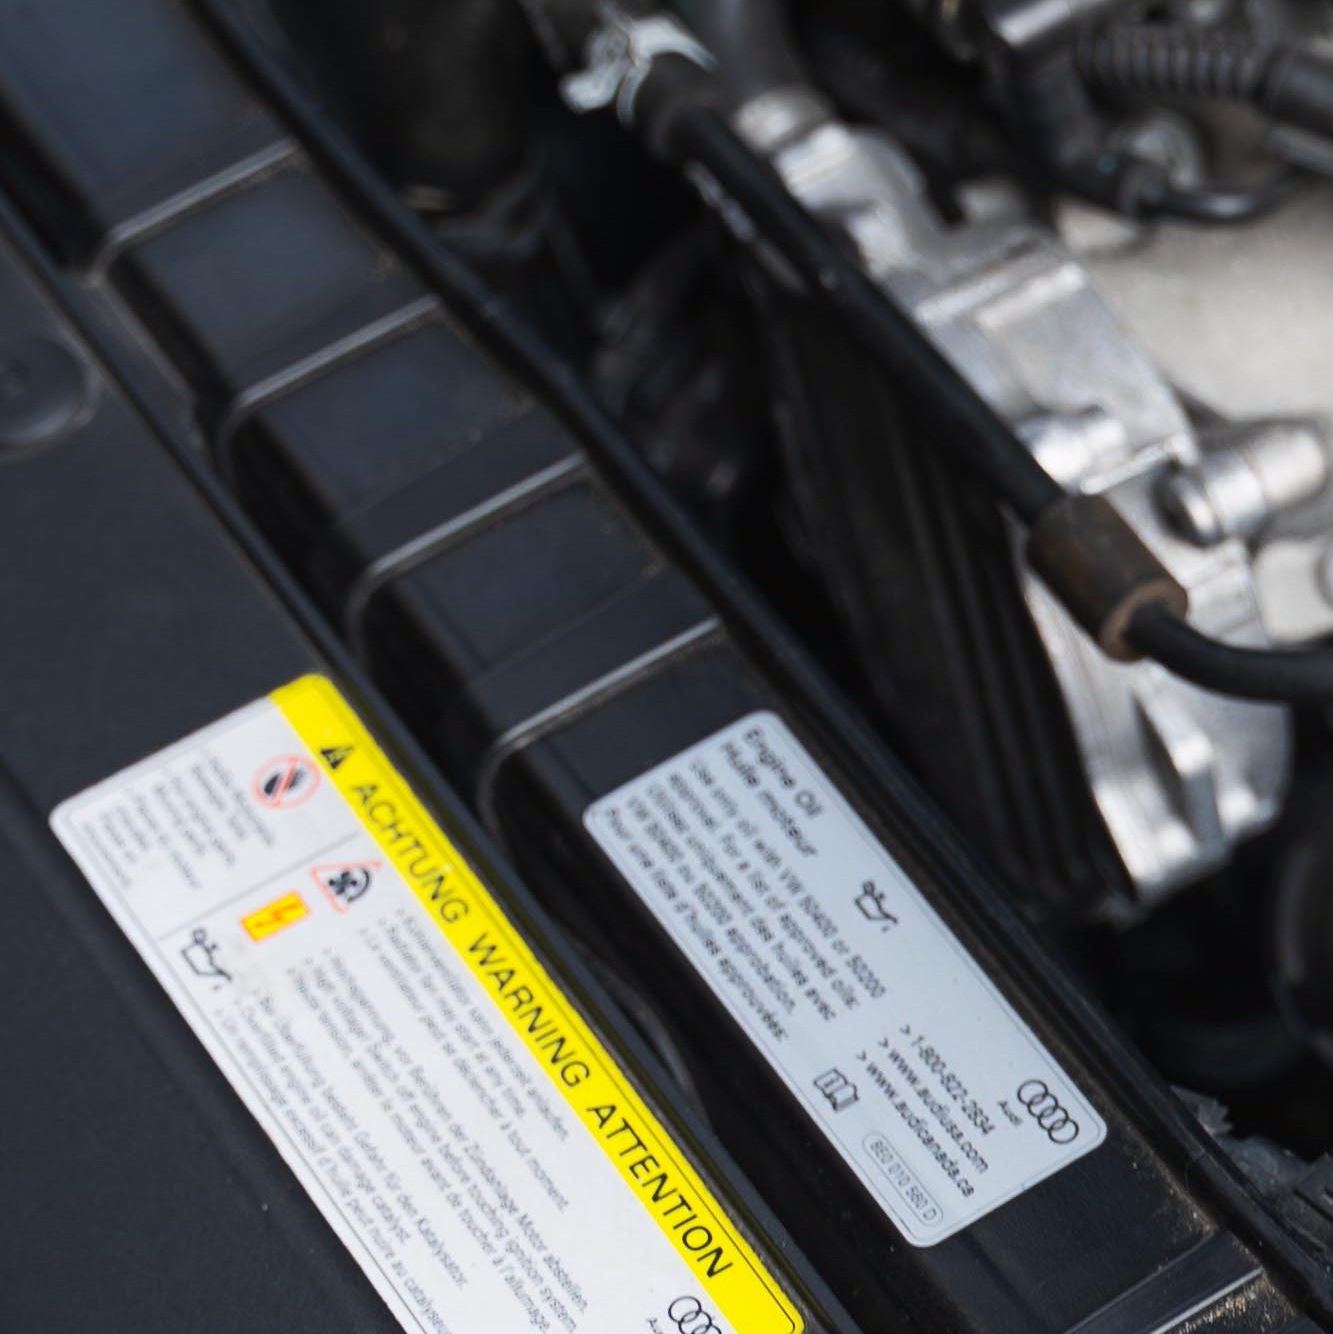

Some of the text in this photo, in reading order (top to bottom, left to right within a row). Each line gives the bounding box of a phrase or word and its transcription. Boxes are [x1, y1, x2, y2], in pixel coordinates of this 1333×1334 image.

[720, 741, 817, 857] Huile moteur
[741, 727, 824, 819] Engine Oil
[351, 780, 733, 1279] ACHTUNG WARNING ATTENTION
[803, 986, 838, 1022] avec
[864, 1062, 976, 1198] www.audicanada.ca
[886, 1048, 990, 1174] www.audiusa.com
[996, 1099, 1023, 1127] Audi
[456, 1207, 497, 1256] toucher
[465, 1183, 511, 1240] touching
[503, 1238, 545, 1287] ignition
[513, 1213, 549, 1253] Motor
